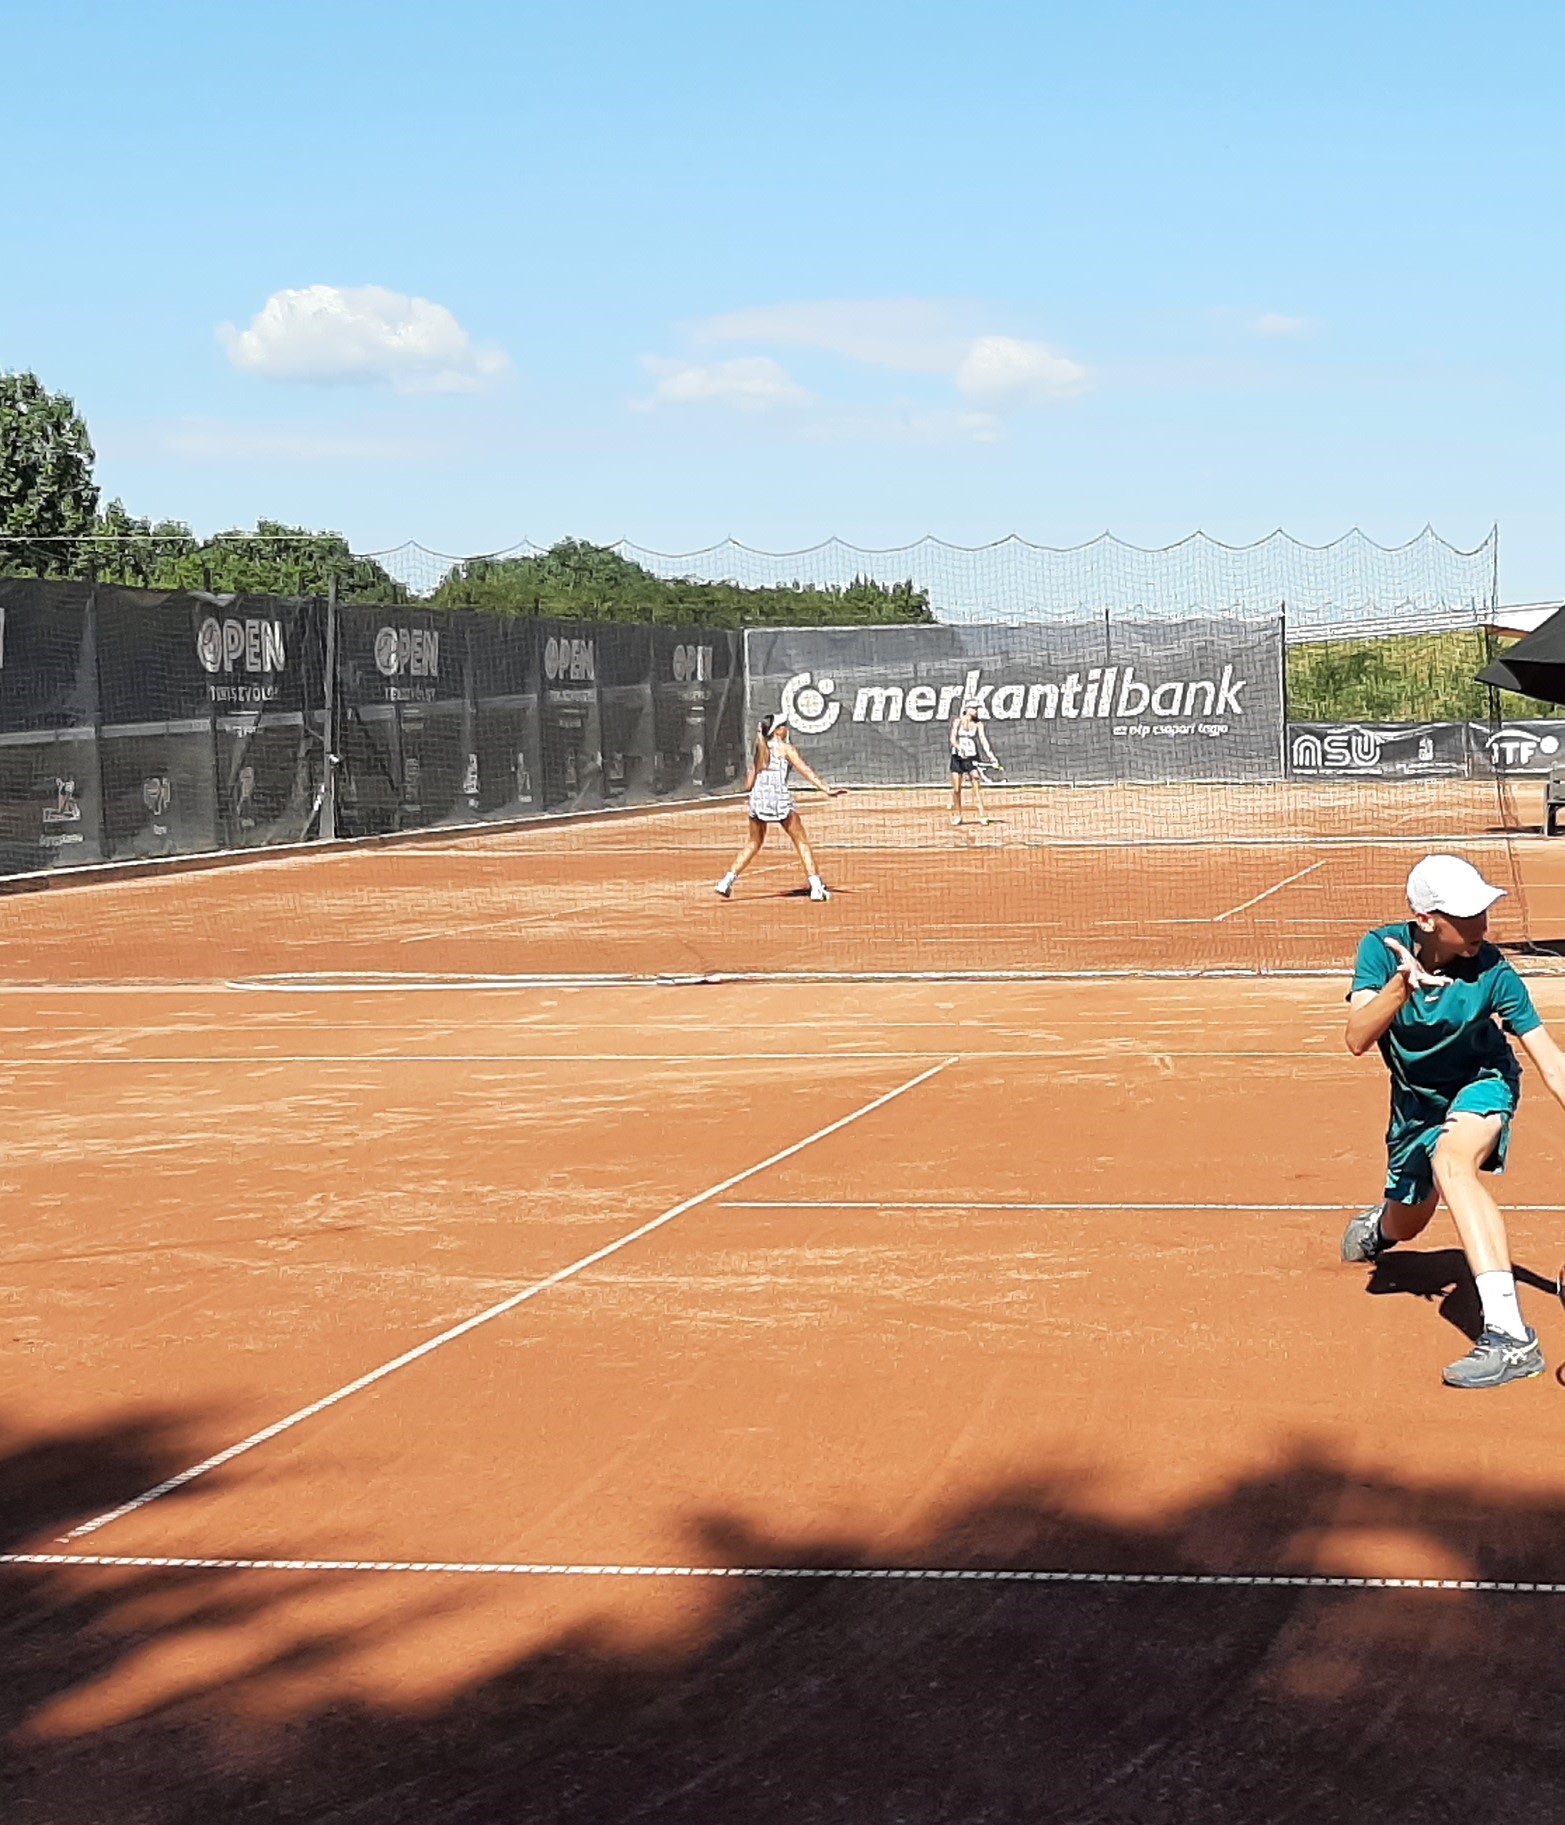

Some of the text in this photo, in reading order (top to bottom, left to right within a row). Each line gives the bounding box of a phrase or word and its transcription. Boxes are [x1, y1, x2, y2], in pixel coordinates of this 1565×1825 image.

[197, 618, 285, 672] OPEN
[375, 627, 439, 676] OPEN
[545, 637, 595, 680] OPEN
[853, 663, 1247, 722] merkantilbank
